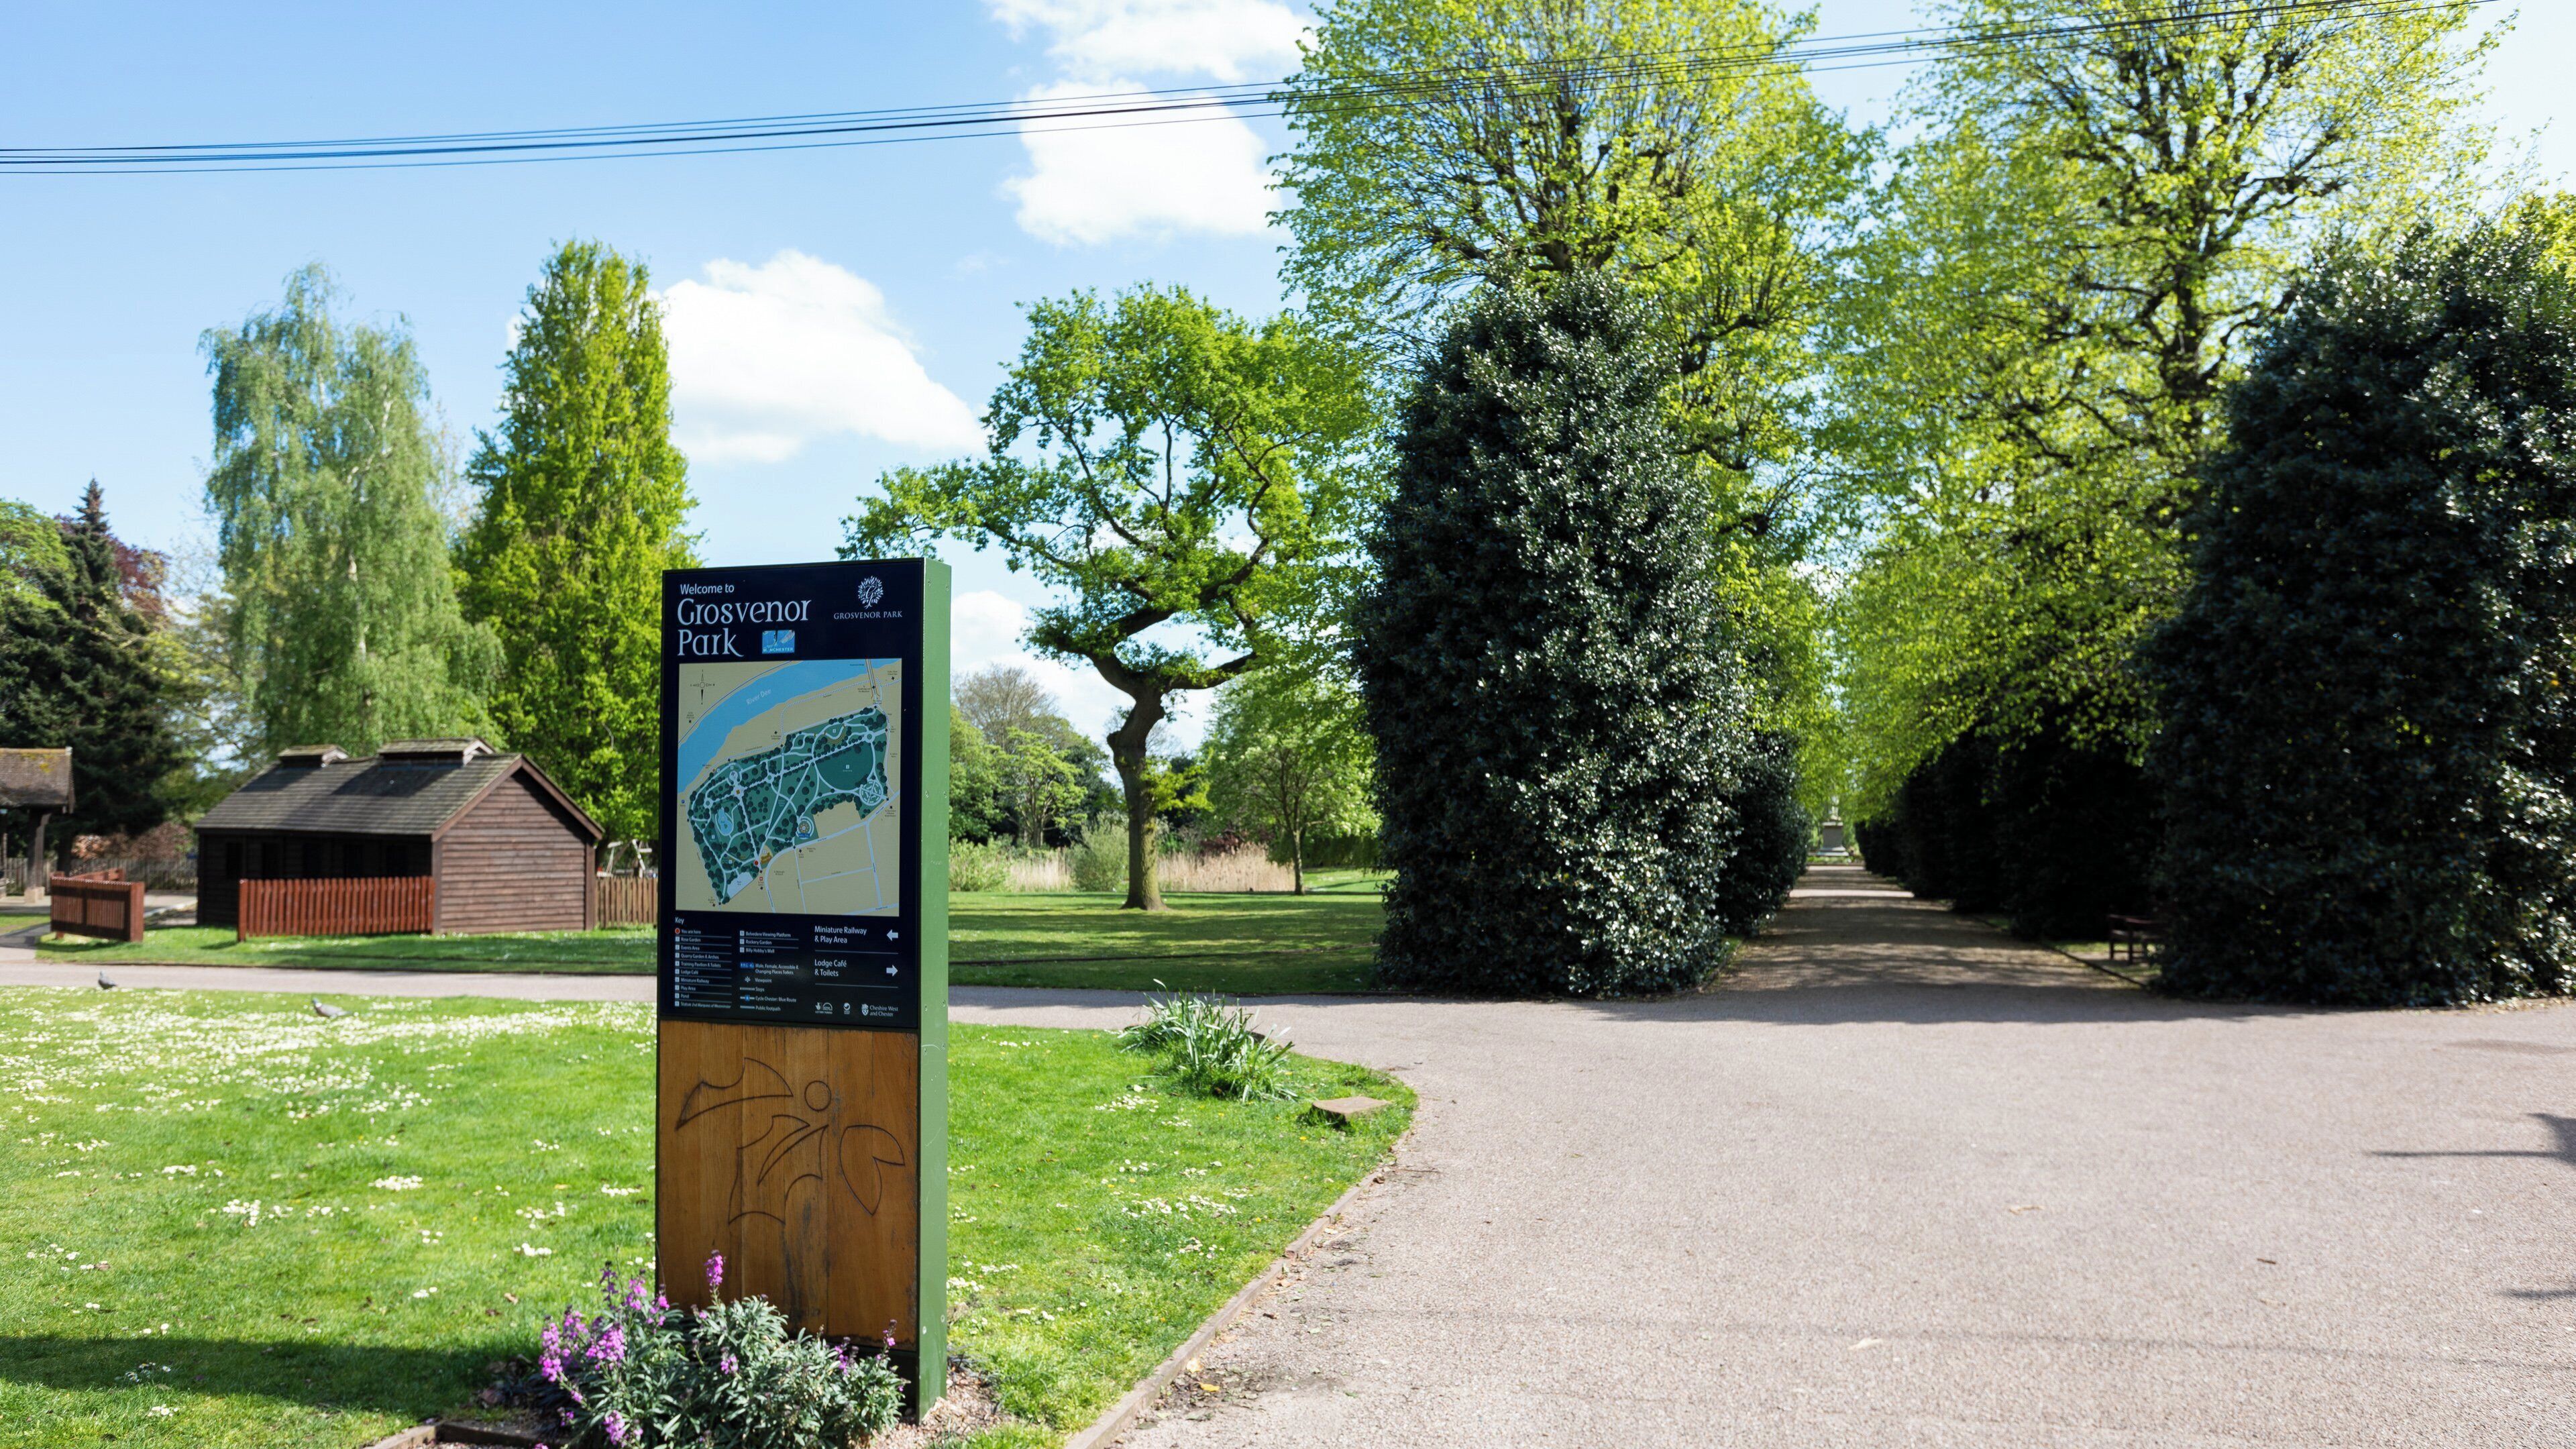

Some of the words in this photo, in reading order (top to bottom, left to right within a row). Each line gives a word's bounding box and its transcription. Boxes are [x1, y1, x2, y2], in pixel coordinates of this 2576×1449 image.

[680, 584, 722, 595] Welcome
[724, 583, 735, 593] to
[678, 598, 812, 626] Grosvenor
[833, 611, 881, 620] GROSVENOR
[883, 610, 903, 619] PARK
[678, 628, 744, 657] Park
[747, 694, 759, 705] River
[760, 689, 771, 698] Dee
[675, 916, 684, 924] Key
[814, 926, 843, 934] Miniature
[844, 926, 867, 936] Railway
[820, 936, 833, 945] Play
[814, 959, 833, 967] Lodge
[833, 959, 847, 967] Café
[820, 969, 839, 977] Toilets
